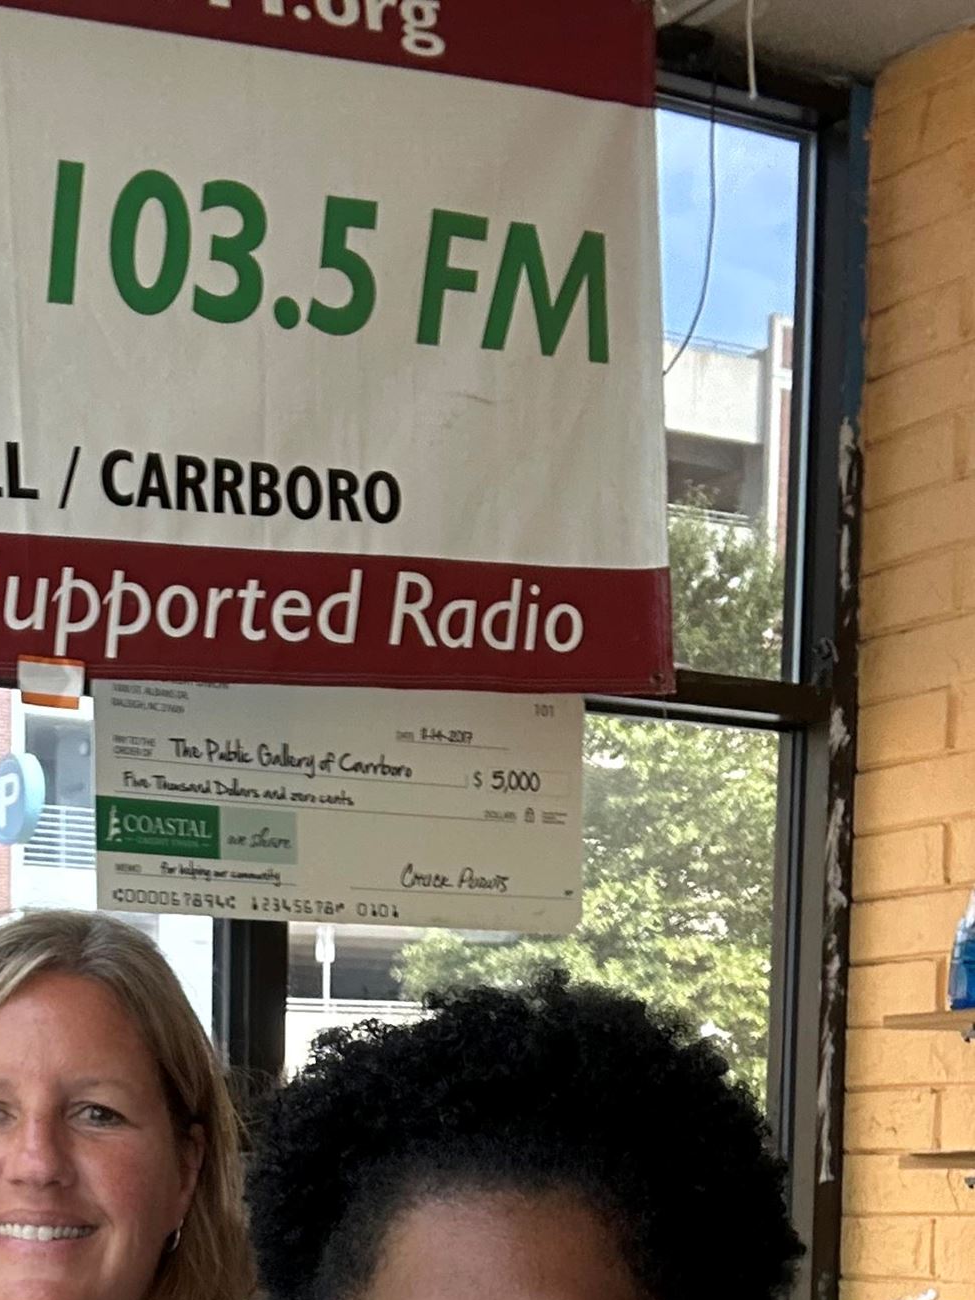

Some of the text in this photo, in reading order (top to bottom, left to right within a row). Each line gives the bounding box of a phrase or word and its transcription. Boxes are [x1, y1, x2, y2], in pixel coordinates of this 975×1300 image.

[209, 0, 445, 56] .org
[47, 159, 609, 364] 103.5 FM
[59, 446, 81, 510] /
[101, 449, 402, 524] CARRBORO
[388, 578, 584, 653] Radio
[534, 703, 555, 718] 101
[123, 770, 150, 788] Five
[152, 774, 211, 794] Thousand
[213, 777, 260, 798] Dollars
[263, 786, 286, 800] and
[168, 737, 541, 794] The Public Gallery of Carrboro $ 5,000
[123, 813, 213, 839] COASTAL
[230, 868, 281, 887] community
